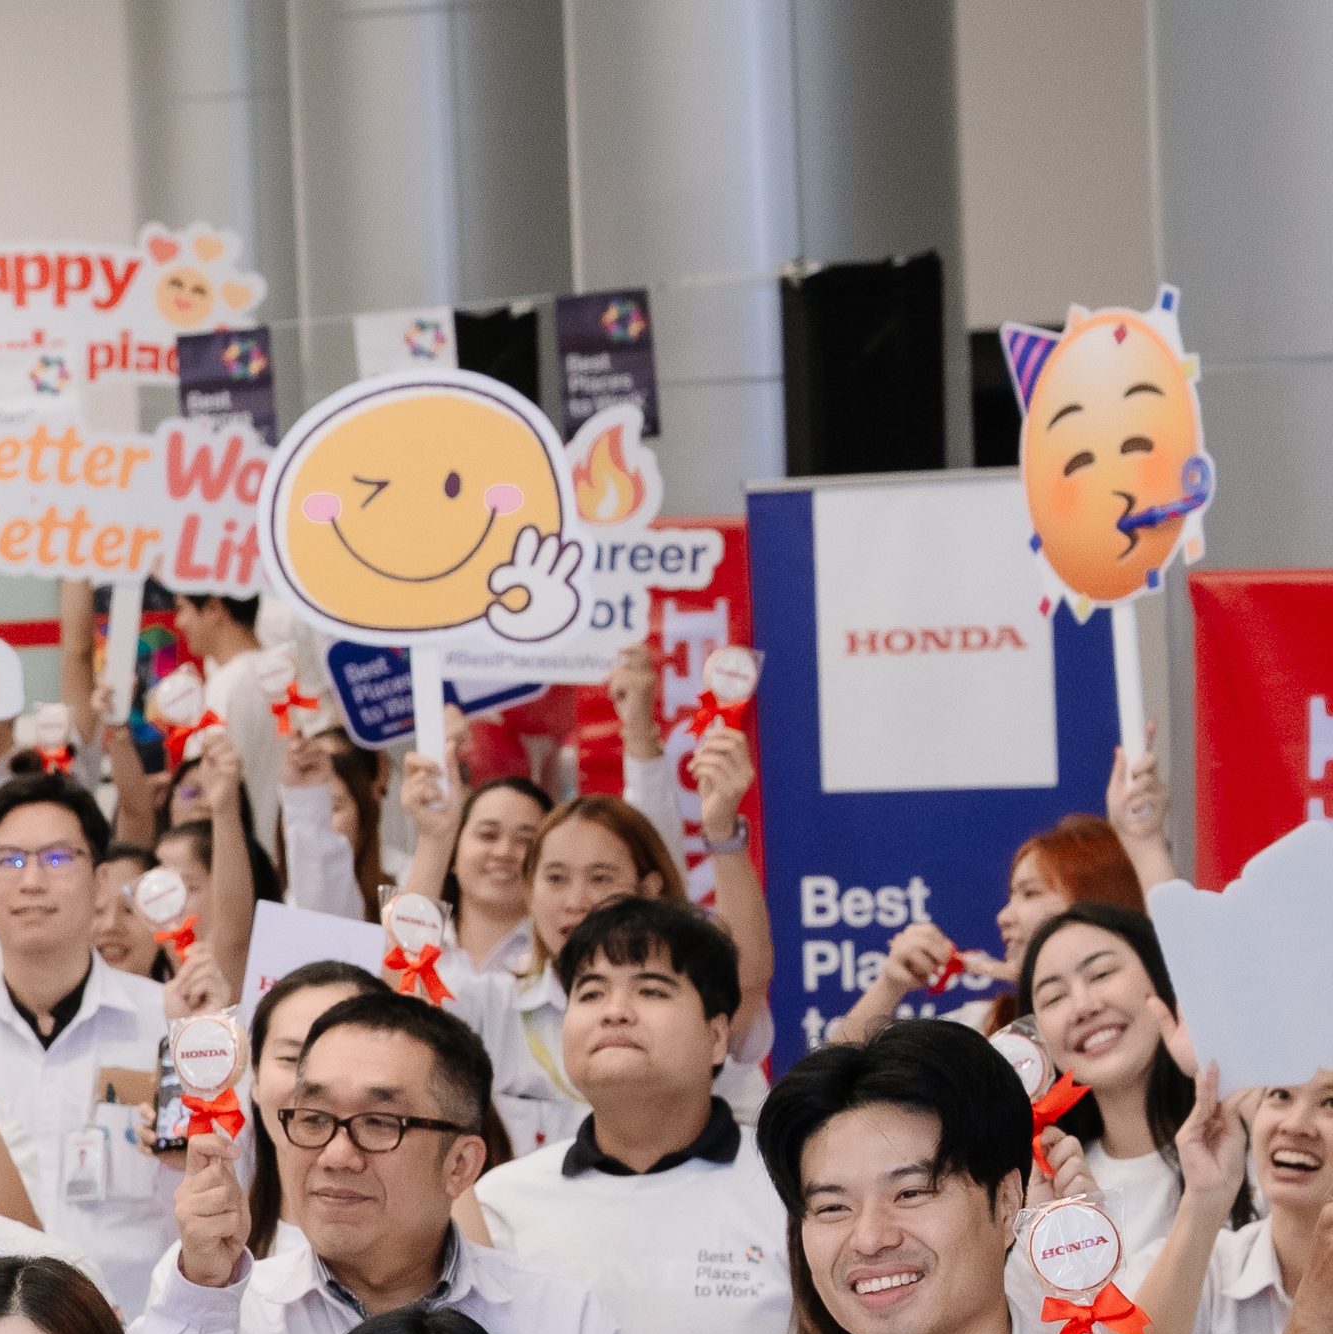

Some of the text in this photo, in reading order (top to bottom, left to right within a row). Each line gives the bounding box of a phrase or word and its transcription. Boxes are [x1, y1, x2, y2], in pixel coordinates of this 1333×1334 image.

[166, 430, 267, 506] Wo
[174, 513, 260, 586] Lif
[844, 624, 1029, 657] HONDA
[800, 875, 931, 928] Best
[180, 1048, 229, 1060] HONDA
[1040, 1235, 1109, 1261] HONDA
